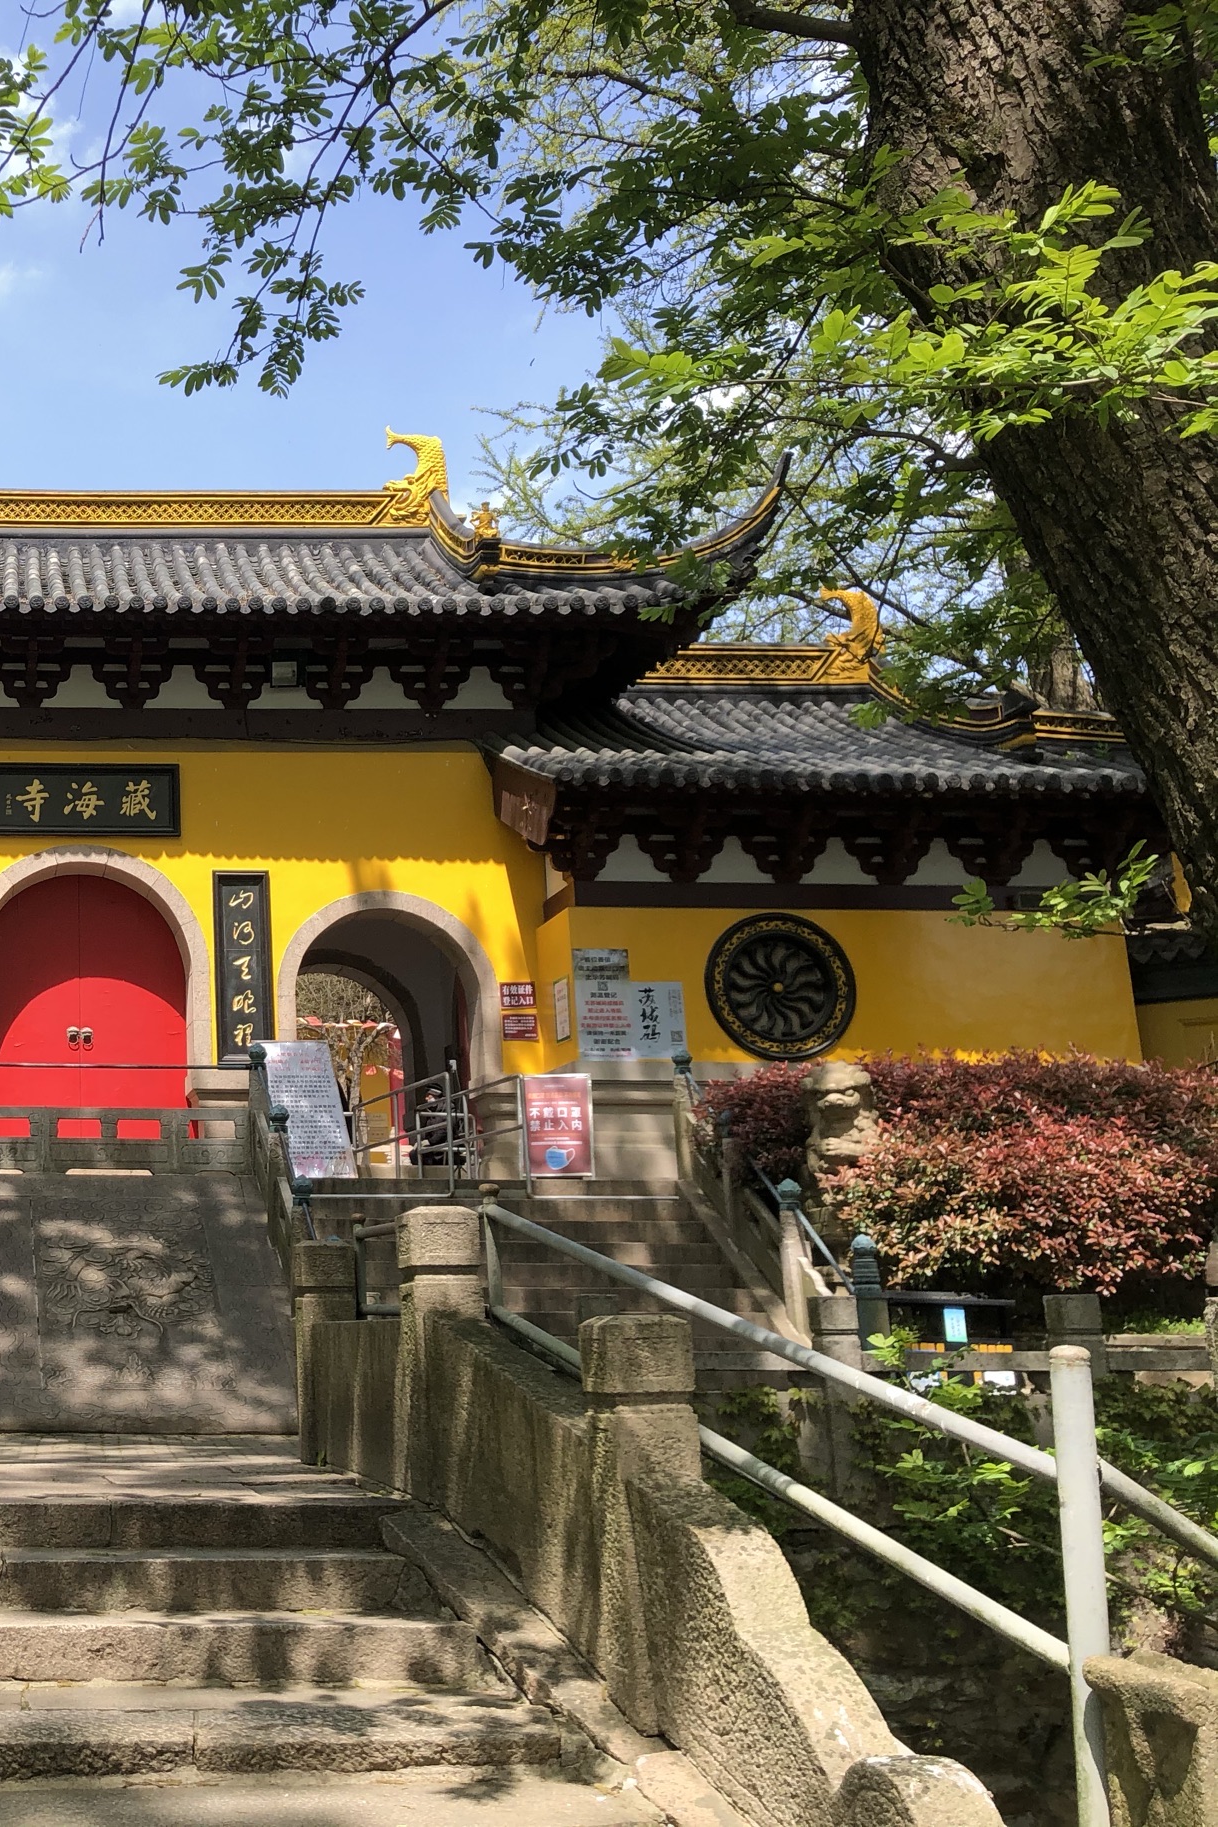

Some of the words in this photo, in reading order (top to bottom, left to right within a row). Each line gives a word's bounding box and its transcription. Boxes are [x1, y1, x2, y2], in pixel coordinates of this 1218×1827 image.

[15, 778, 157, 823] 藏海寺
[502, 984, 534, 996] 有效证件
[503, 996, 534, 1006] 登记入口
[638, 986, 661, 1043] 苏城码
[529, 1106, 582, 1119] 不戴口罩
[530, 1119, 583, 1132] 禁止入内
